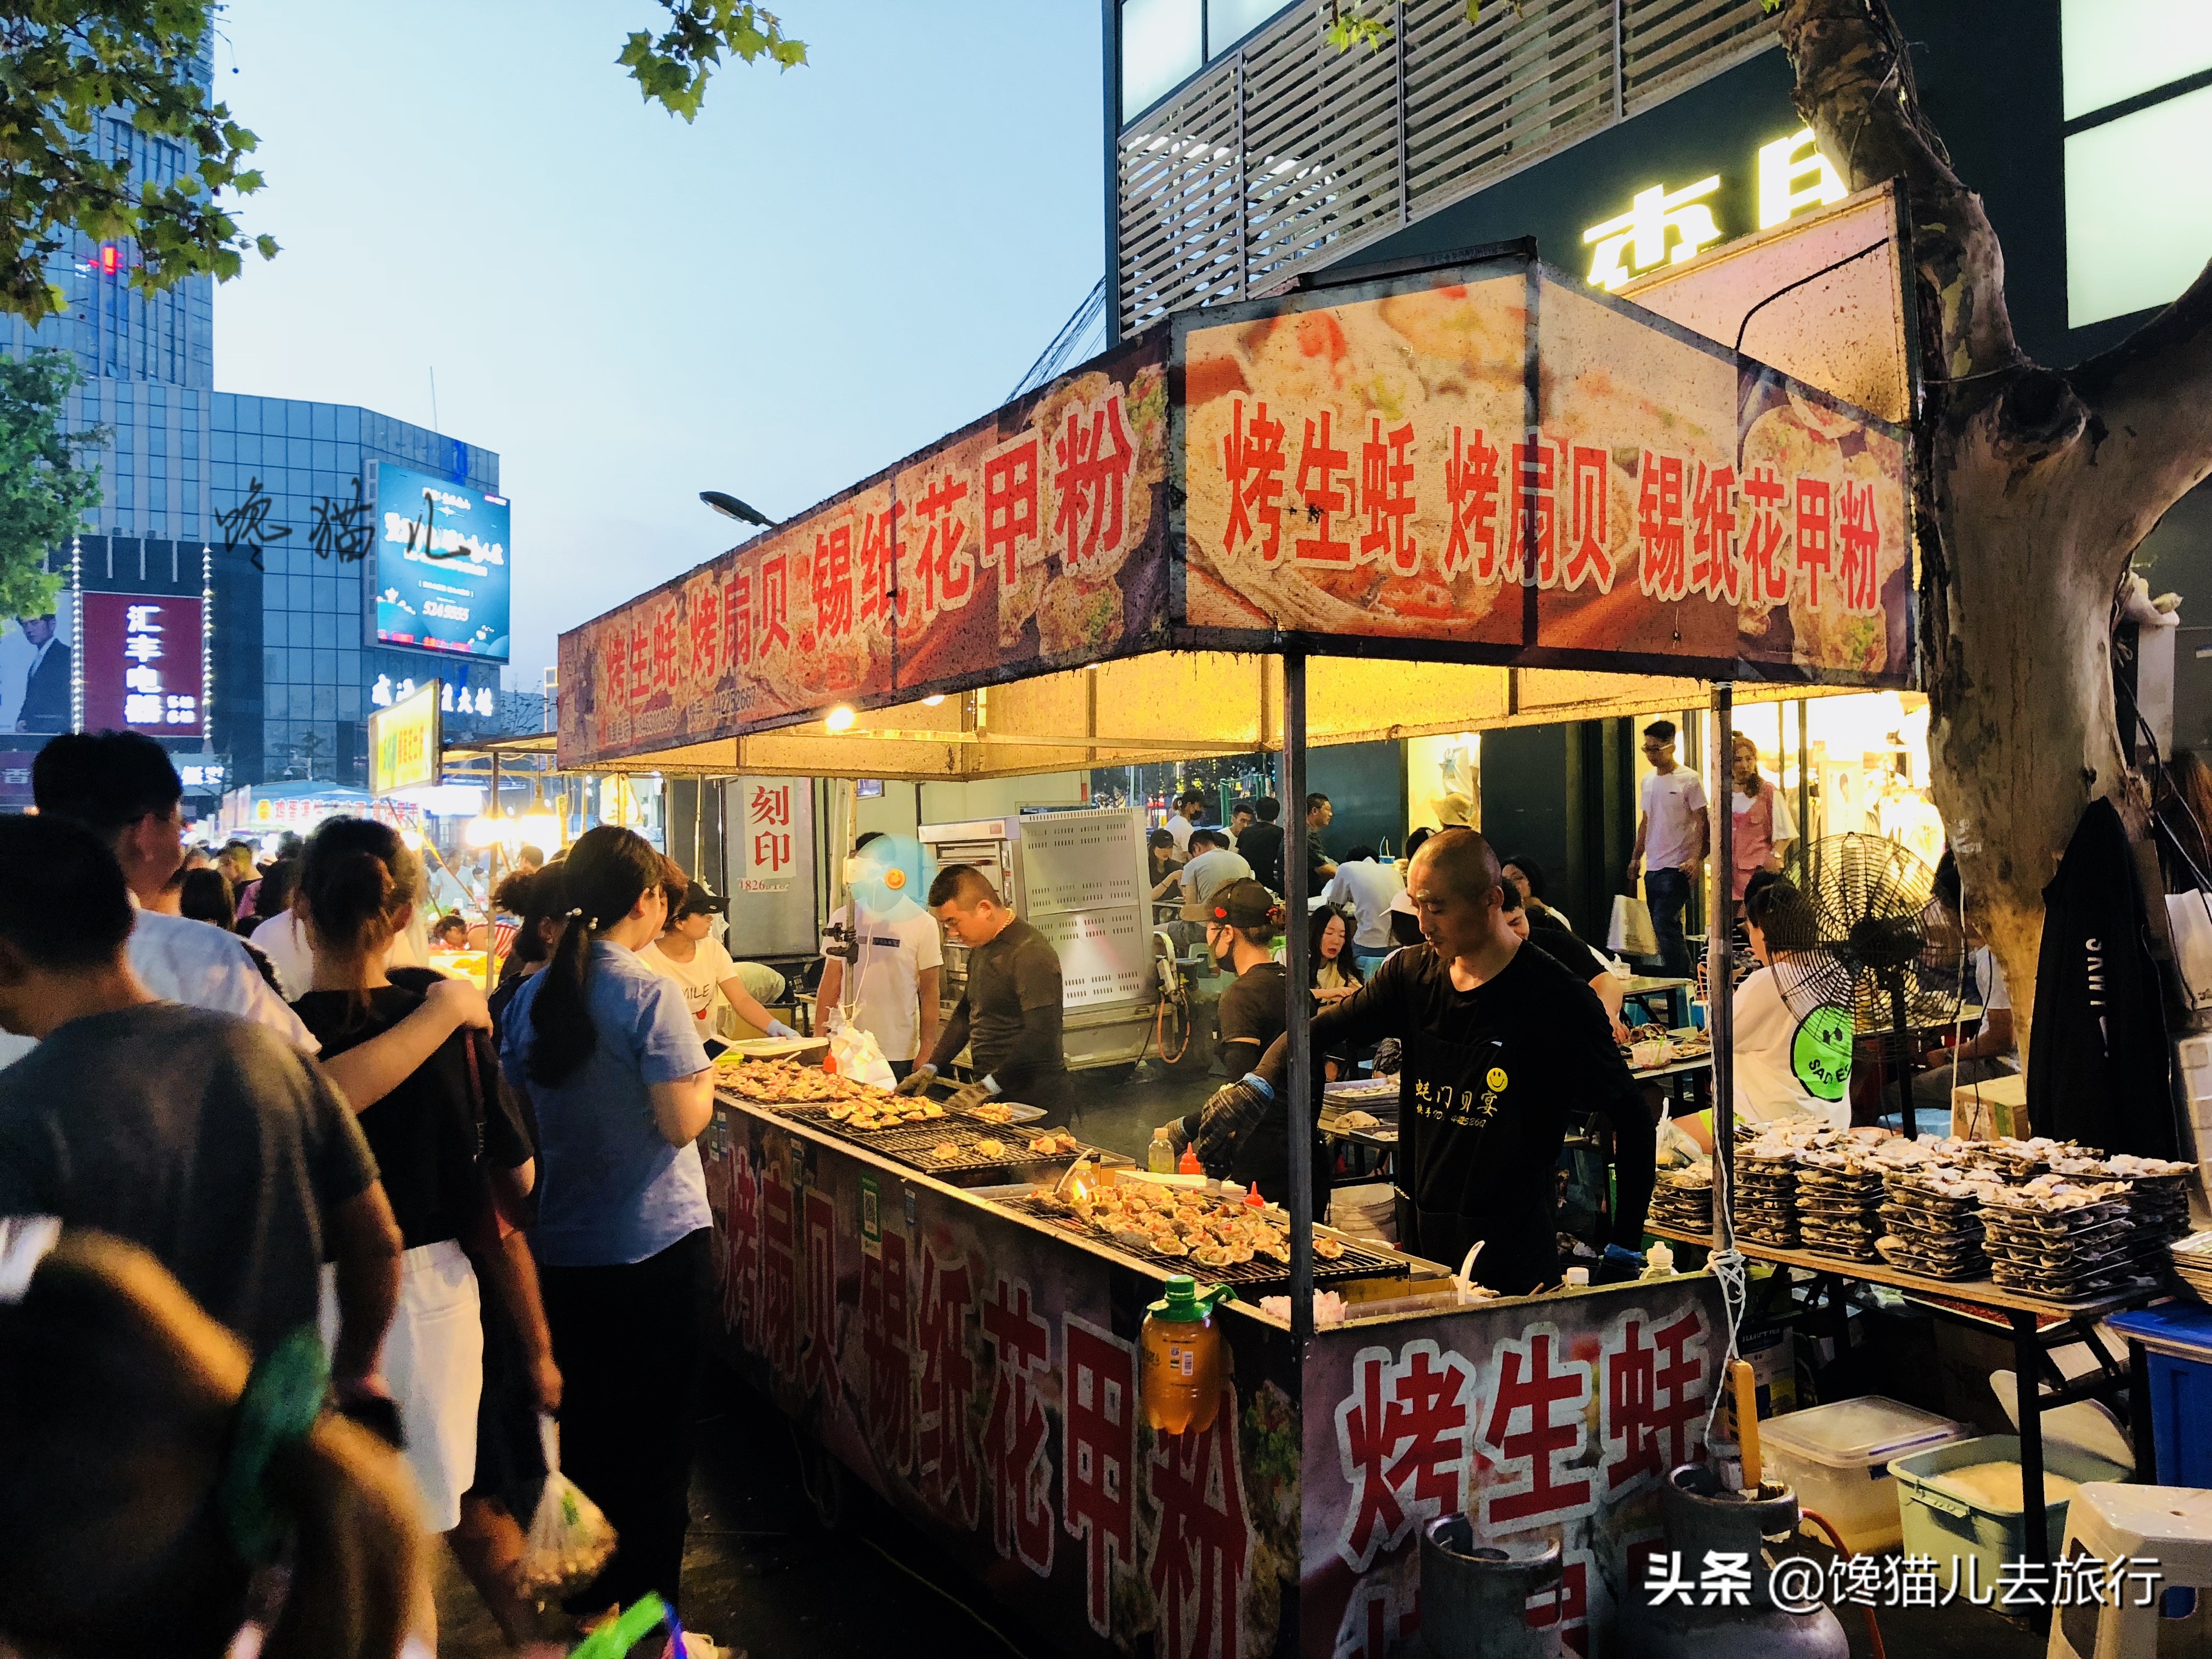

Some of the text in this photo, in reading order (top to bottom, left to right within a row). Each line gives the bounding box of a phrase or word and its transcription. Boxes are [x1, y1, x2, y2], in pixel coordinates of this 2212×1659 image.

[605, 605, 679, 706] 烤生蚝
[689, 552, 791, 676] 烤扇贝
[810, 396, 1133, 640] 锡纸花甲粉
[1224, 399, 1880, 608] 烤生蚝 烤扇贝 锡纸花甲粉
[750, 786, 790, 871] 刻印
[1345, 1312, 1707, 1559] 烤生蚝
